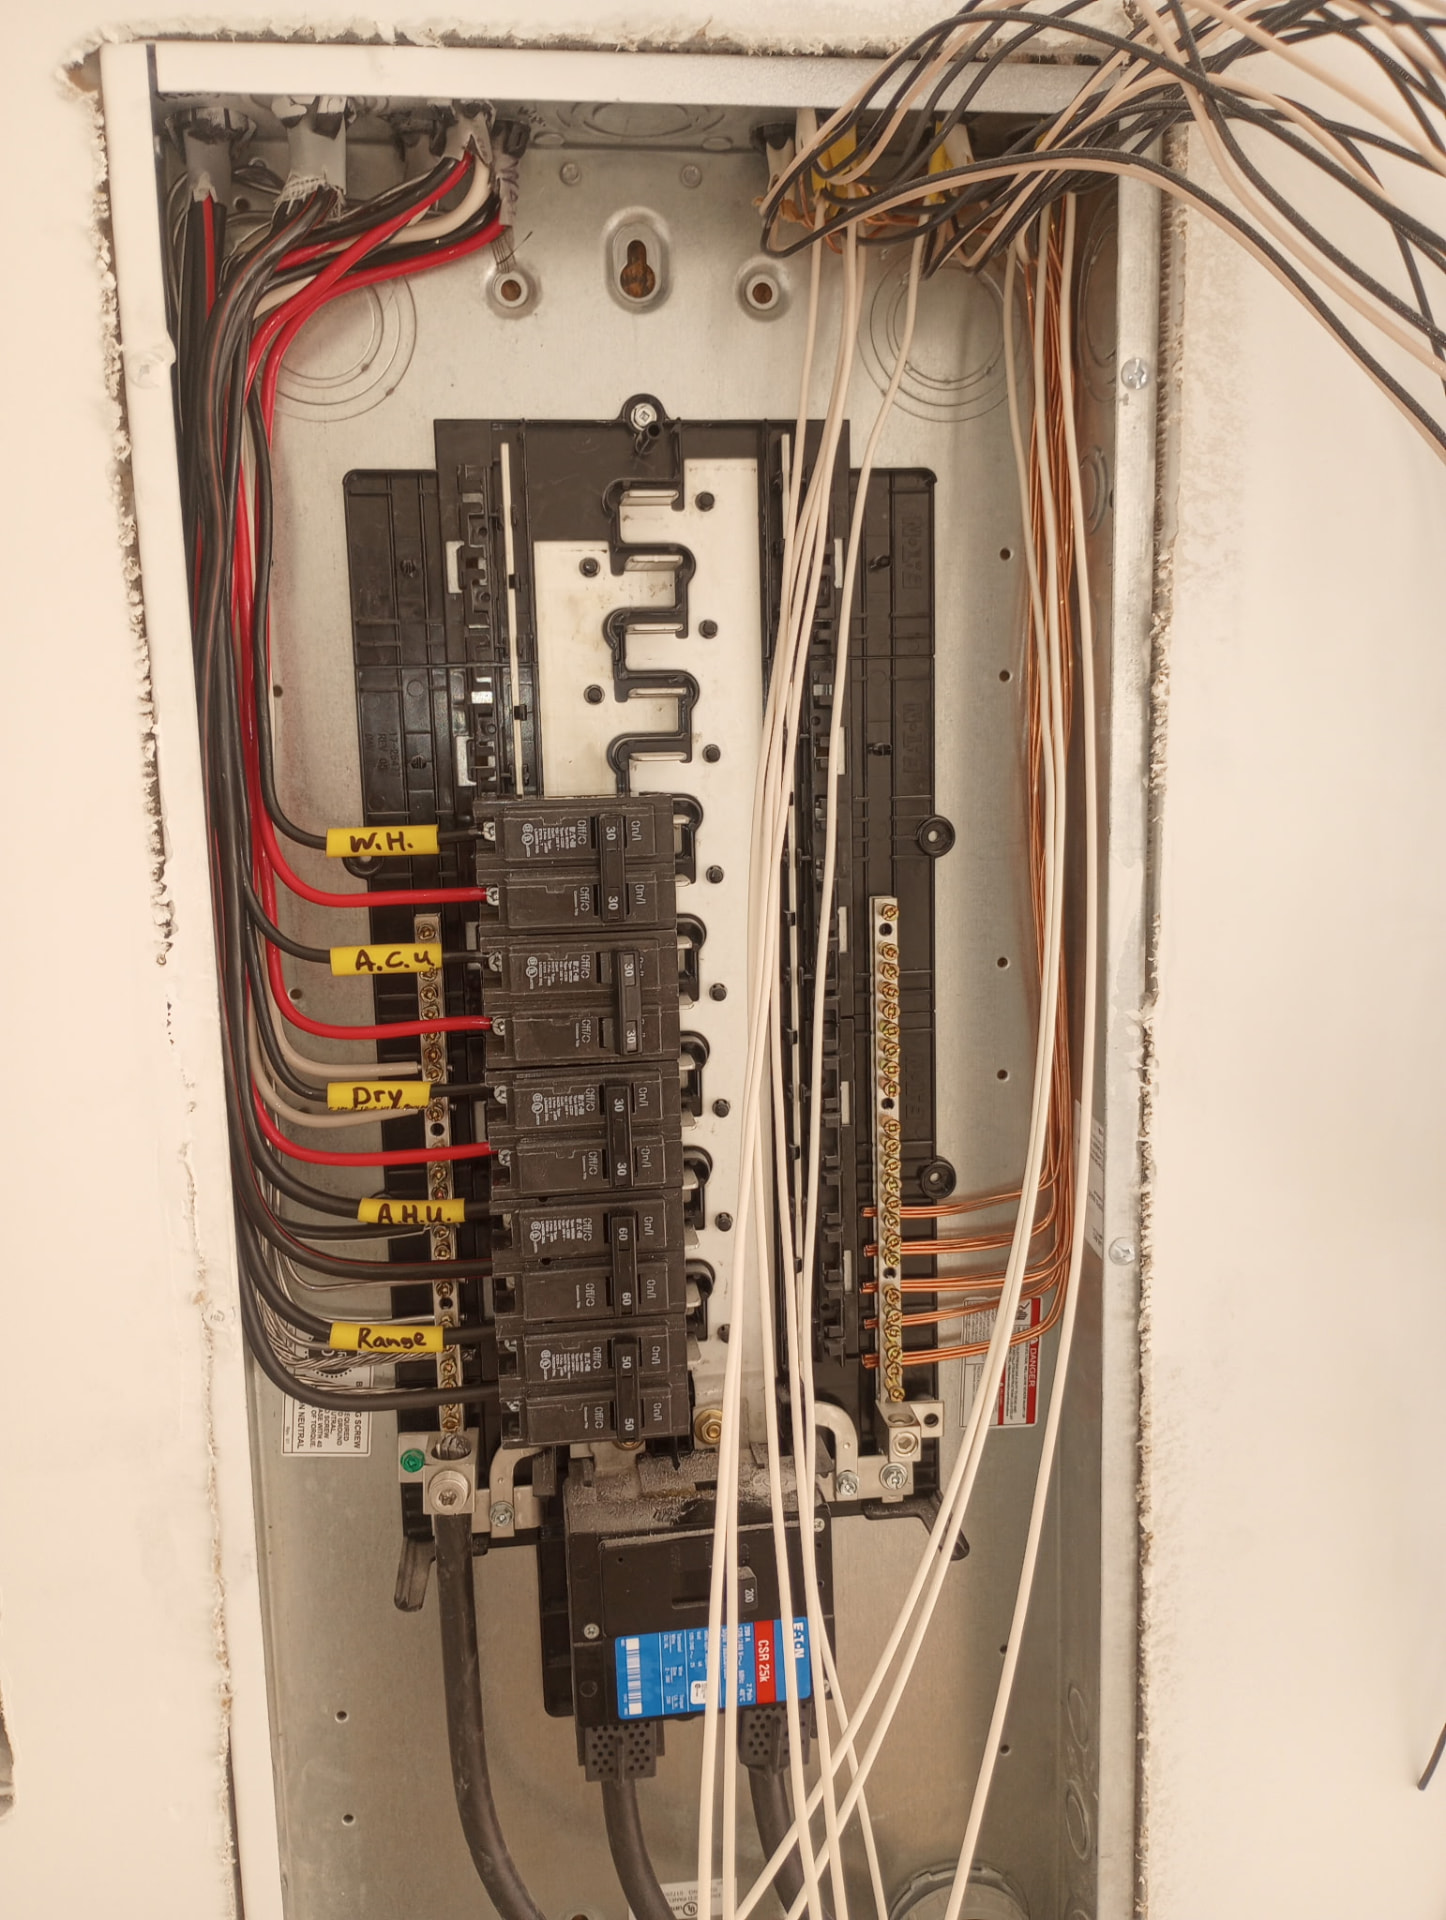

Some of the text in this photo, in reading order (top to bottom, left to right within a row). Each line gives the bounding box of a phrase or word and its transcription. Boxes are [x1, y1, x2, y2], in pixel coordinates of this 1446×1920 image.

[606, 826, 616, 840] 30
[350, 831, 414, 852] W.H.
[608, 896, 618, 910] 30
[624, 963, 634, 977] 30
[626, 1030, 636, 1043] 30
[614, 1098, 624, 1112] 30
[617, 1162, 627, 1176] 30
[378, 1203, 452, 1224] A.H.U.
[619, 1228, 628, 1241] 60
[622, 1292, 631, 1305] 60
[358, 1327, 427, 1349] Range
[622, 1356, 631, 1369] 50
[1028, 1347, 1037, 1387] DANGER
[311, 1410, 316, 1419] OF
[297, 1412, 305, 1449] NEUTRAL
[625, 1418, 634, 1431] 50
[745, 1588, 754, 1603] 200
[758, 1640, 771, 1683] CSR 25k
